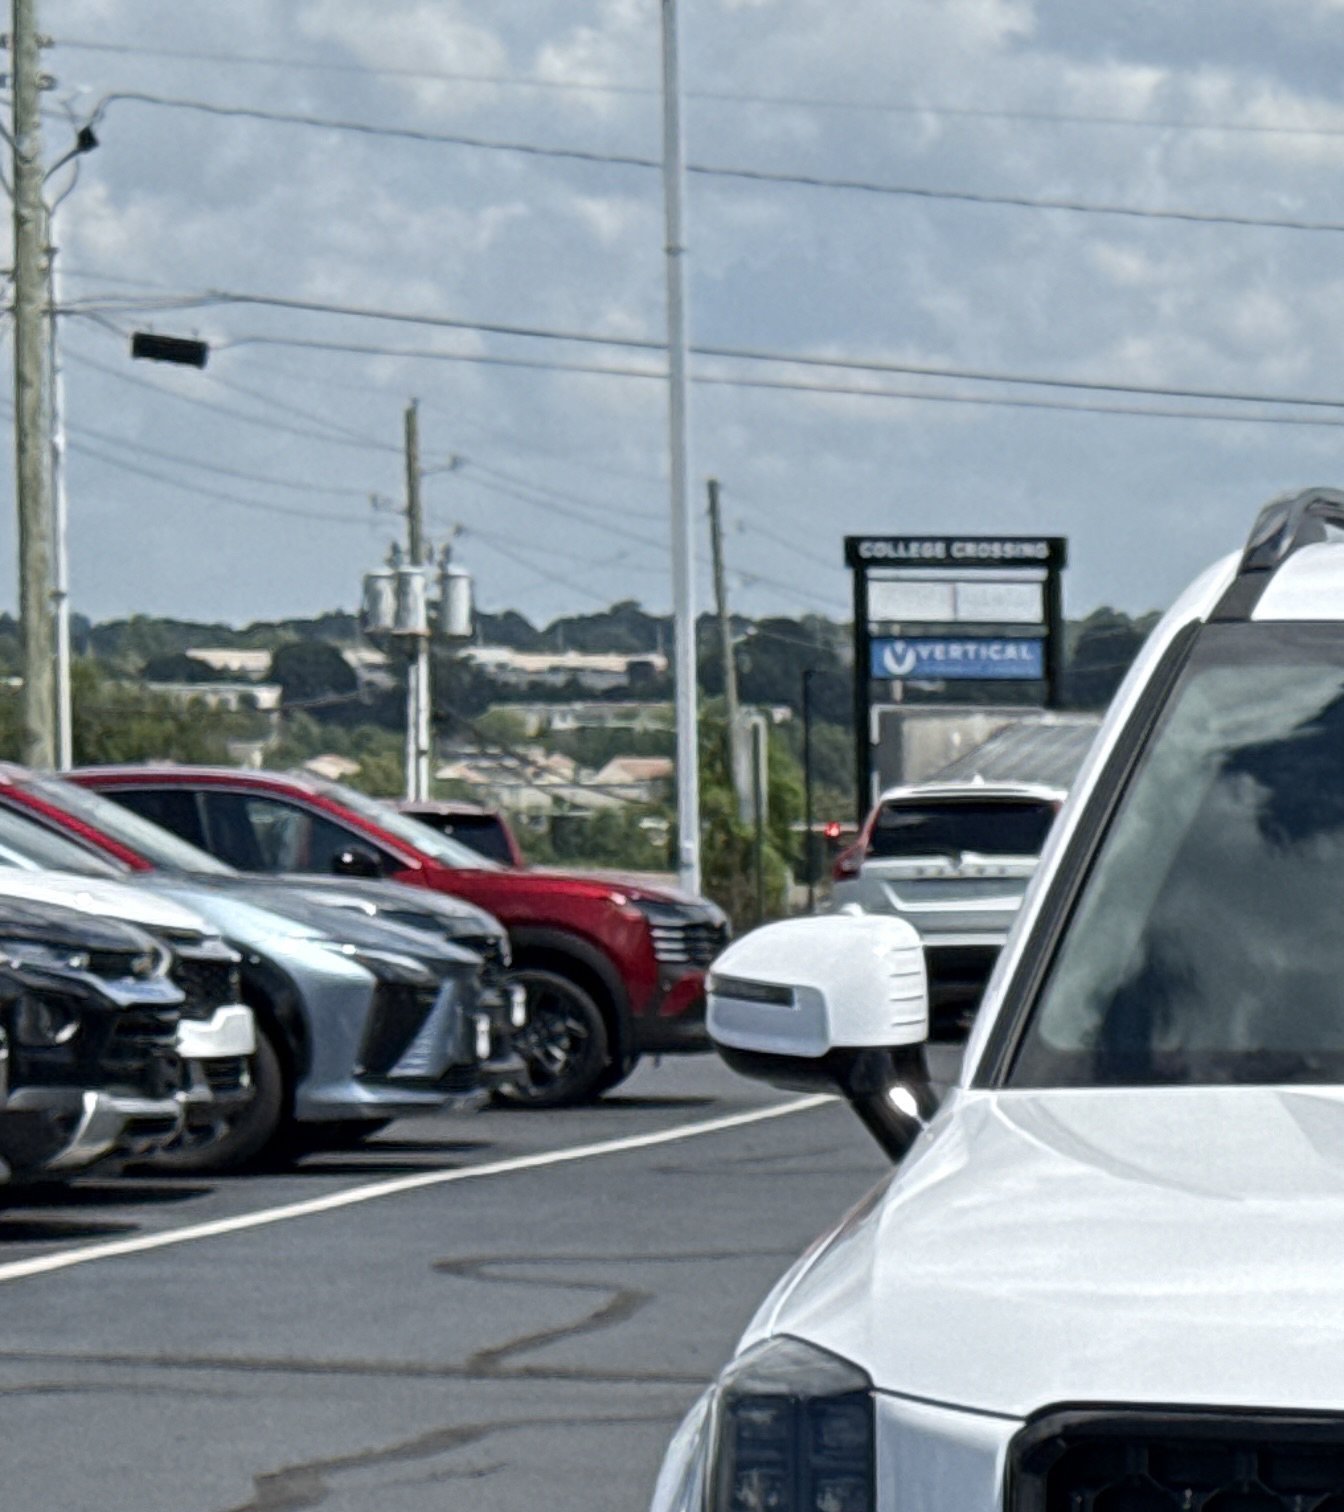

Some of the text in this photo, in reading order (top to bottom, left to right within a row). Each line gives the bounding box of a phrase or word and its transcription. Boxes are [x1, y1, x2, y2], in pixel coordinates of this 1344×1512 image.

[858, 541, 1050, 559] COLLEGE CROSSING
[917, 643, 1033, 660] VERTICAL
